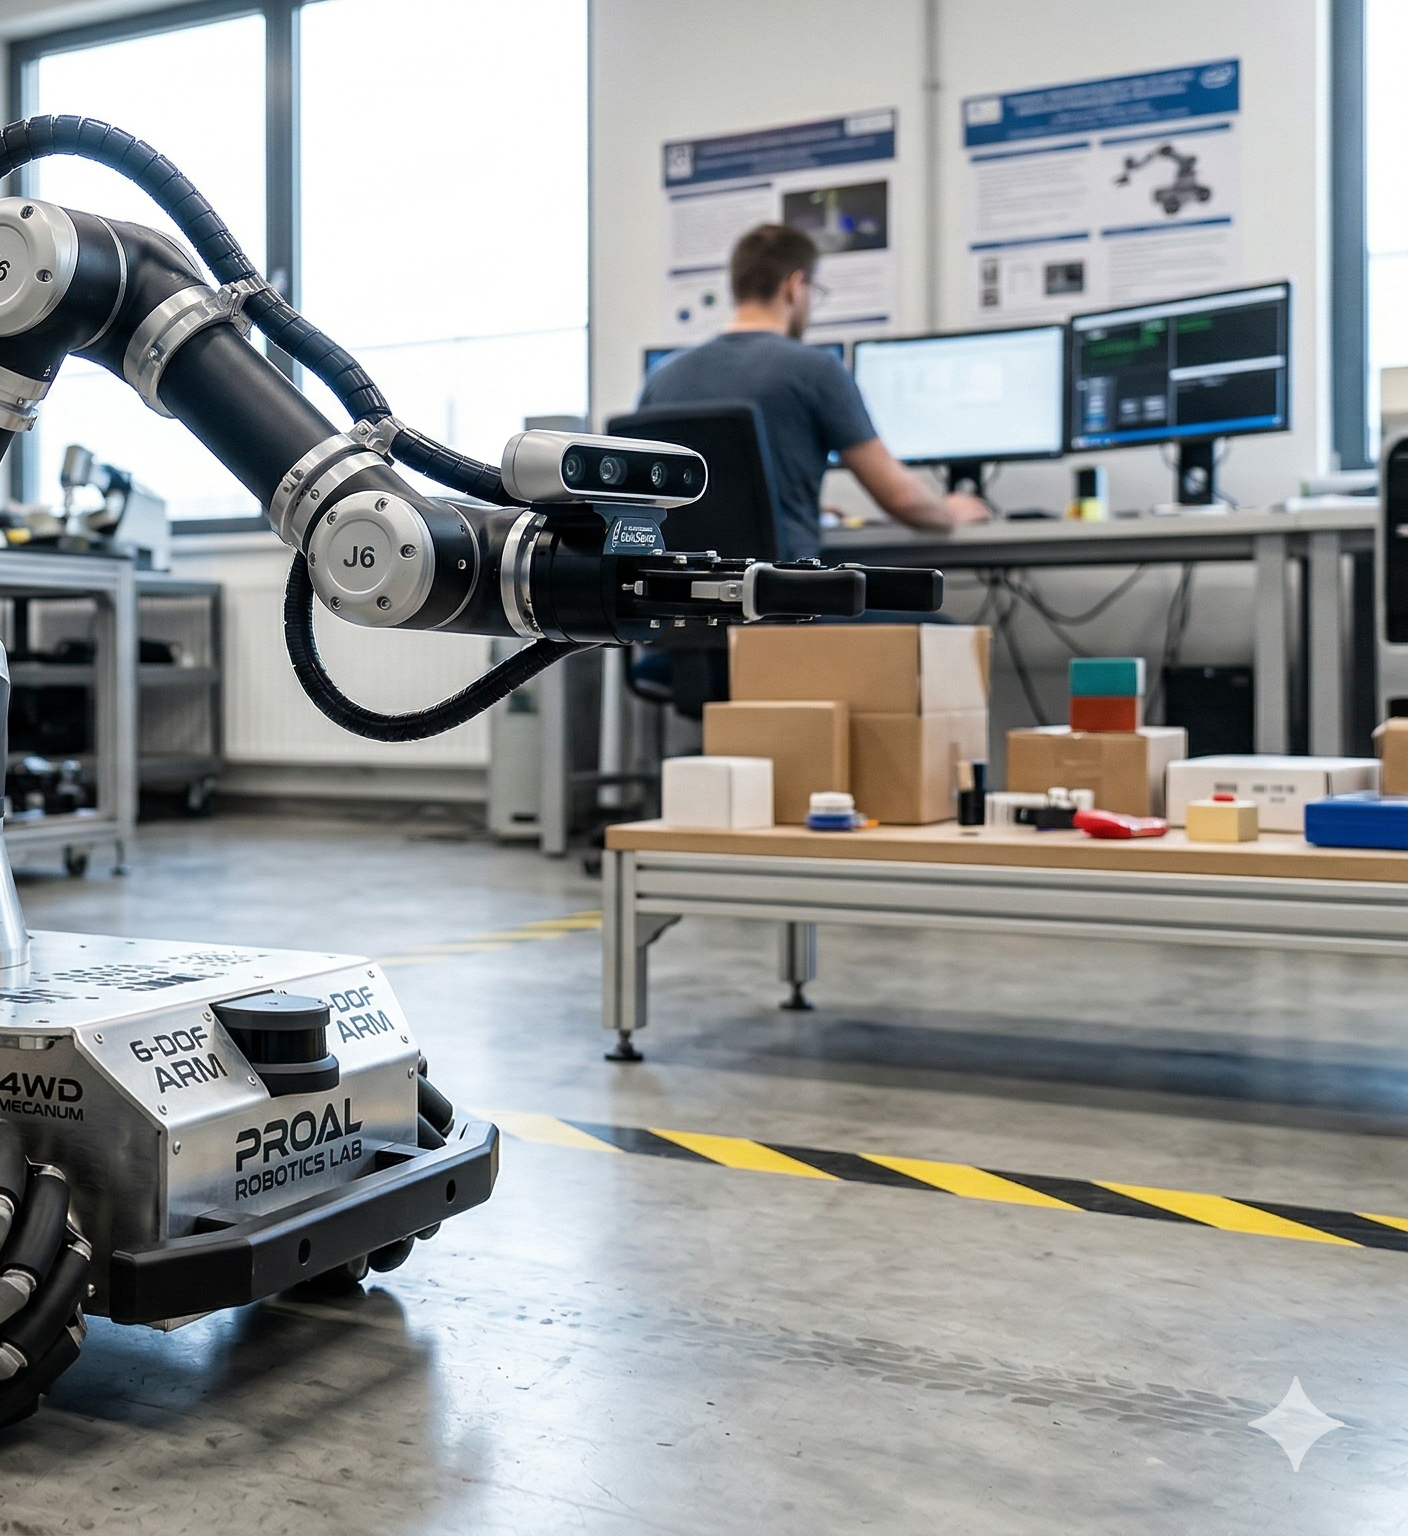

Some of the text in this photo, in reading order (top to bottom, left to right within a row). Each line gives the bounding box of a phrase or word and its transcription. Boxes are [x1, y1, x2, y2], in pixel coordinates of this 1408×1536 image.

[343, 546, 375, 568] J6
[328, 986, 374, 1013] -DOF
[129, 1026, 208, 1062] 6-DOF
[336, 1010, 395, 1043] ARM
[155, 1053, 228, 1094] ARM
[236, 1098, 363, 1172] PROAL
[235, 1139, 362, 1201] ROBOTICS LAB
